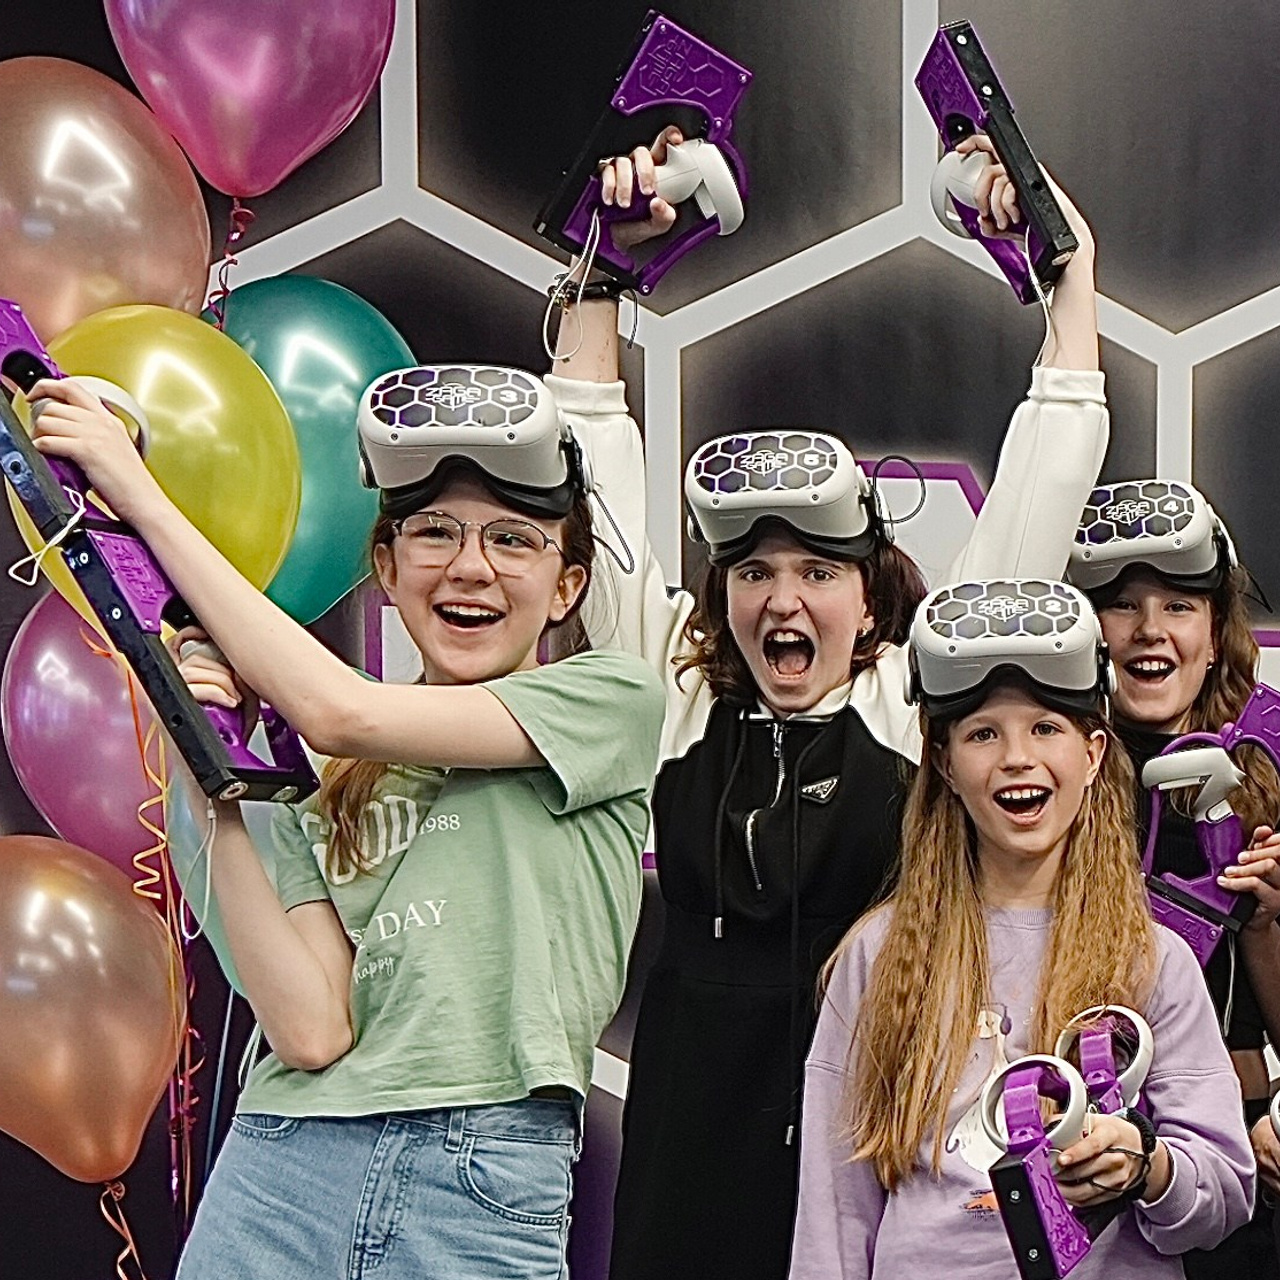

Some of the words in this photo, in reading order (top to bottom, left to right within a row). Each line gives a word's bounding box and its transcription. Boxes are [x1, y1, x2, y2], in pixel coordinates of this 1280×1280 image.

[426, 387, 481, 397] ZAGA
[500, 390, 518, 403] 3
[740, 452, 788, 465] ZAGA
[1106, 502, 1149, 515] ZAGA
[1163, 500, 1179, 513] 4
[978, 599, 1028, 608] ZAGA
[1045, 600, 1061, 612] 2
[375, 900, 447, 941] DAY
